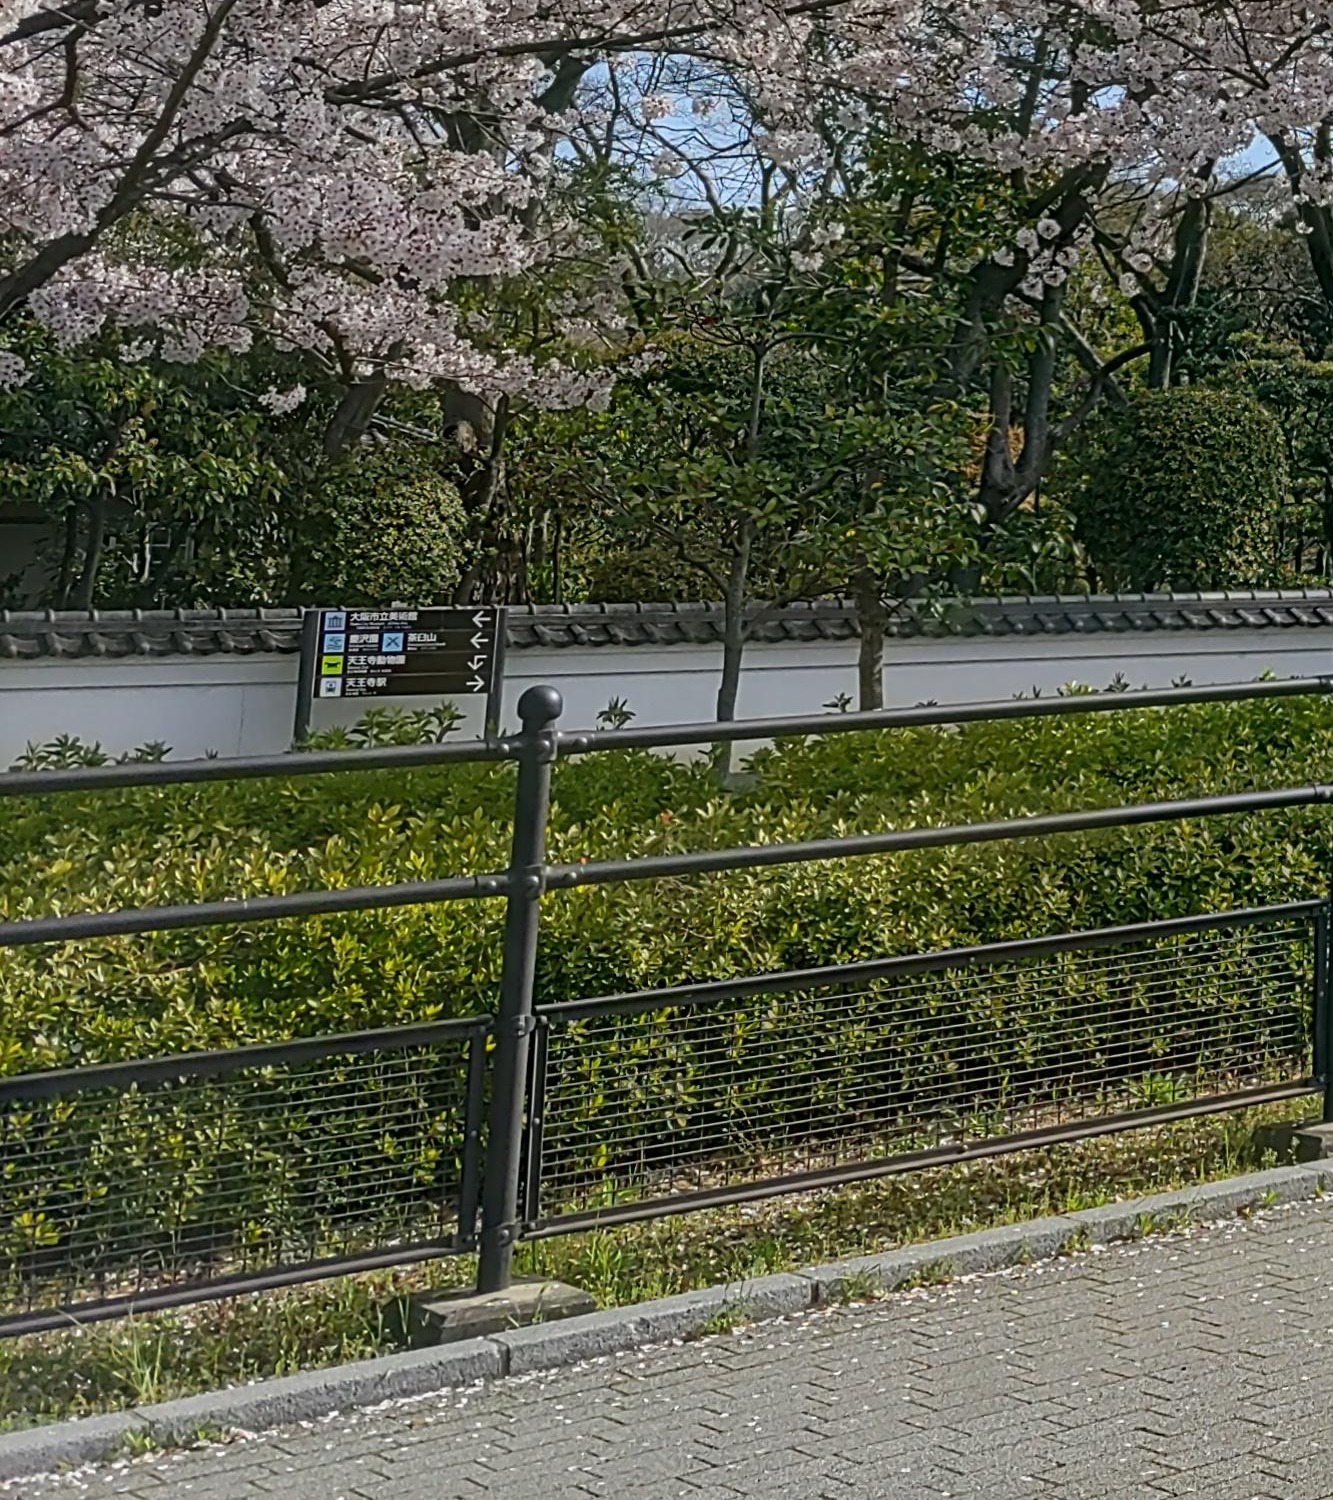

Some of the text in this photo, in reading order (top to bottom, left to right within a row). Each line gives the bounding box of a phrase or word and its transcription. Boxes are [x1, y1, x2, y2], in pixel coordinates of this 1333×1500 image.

[349, 612, 418, 621] 大阪市立美術館
[347, 655, 406, 665] 天王寺動物園
[346, 677, 387, 687] 天王寺駅
